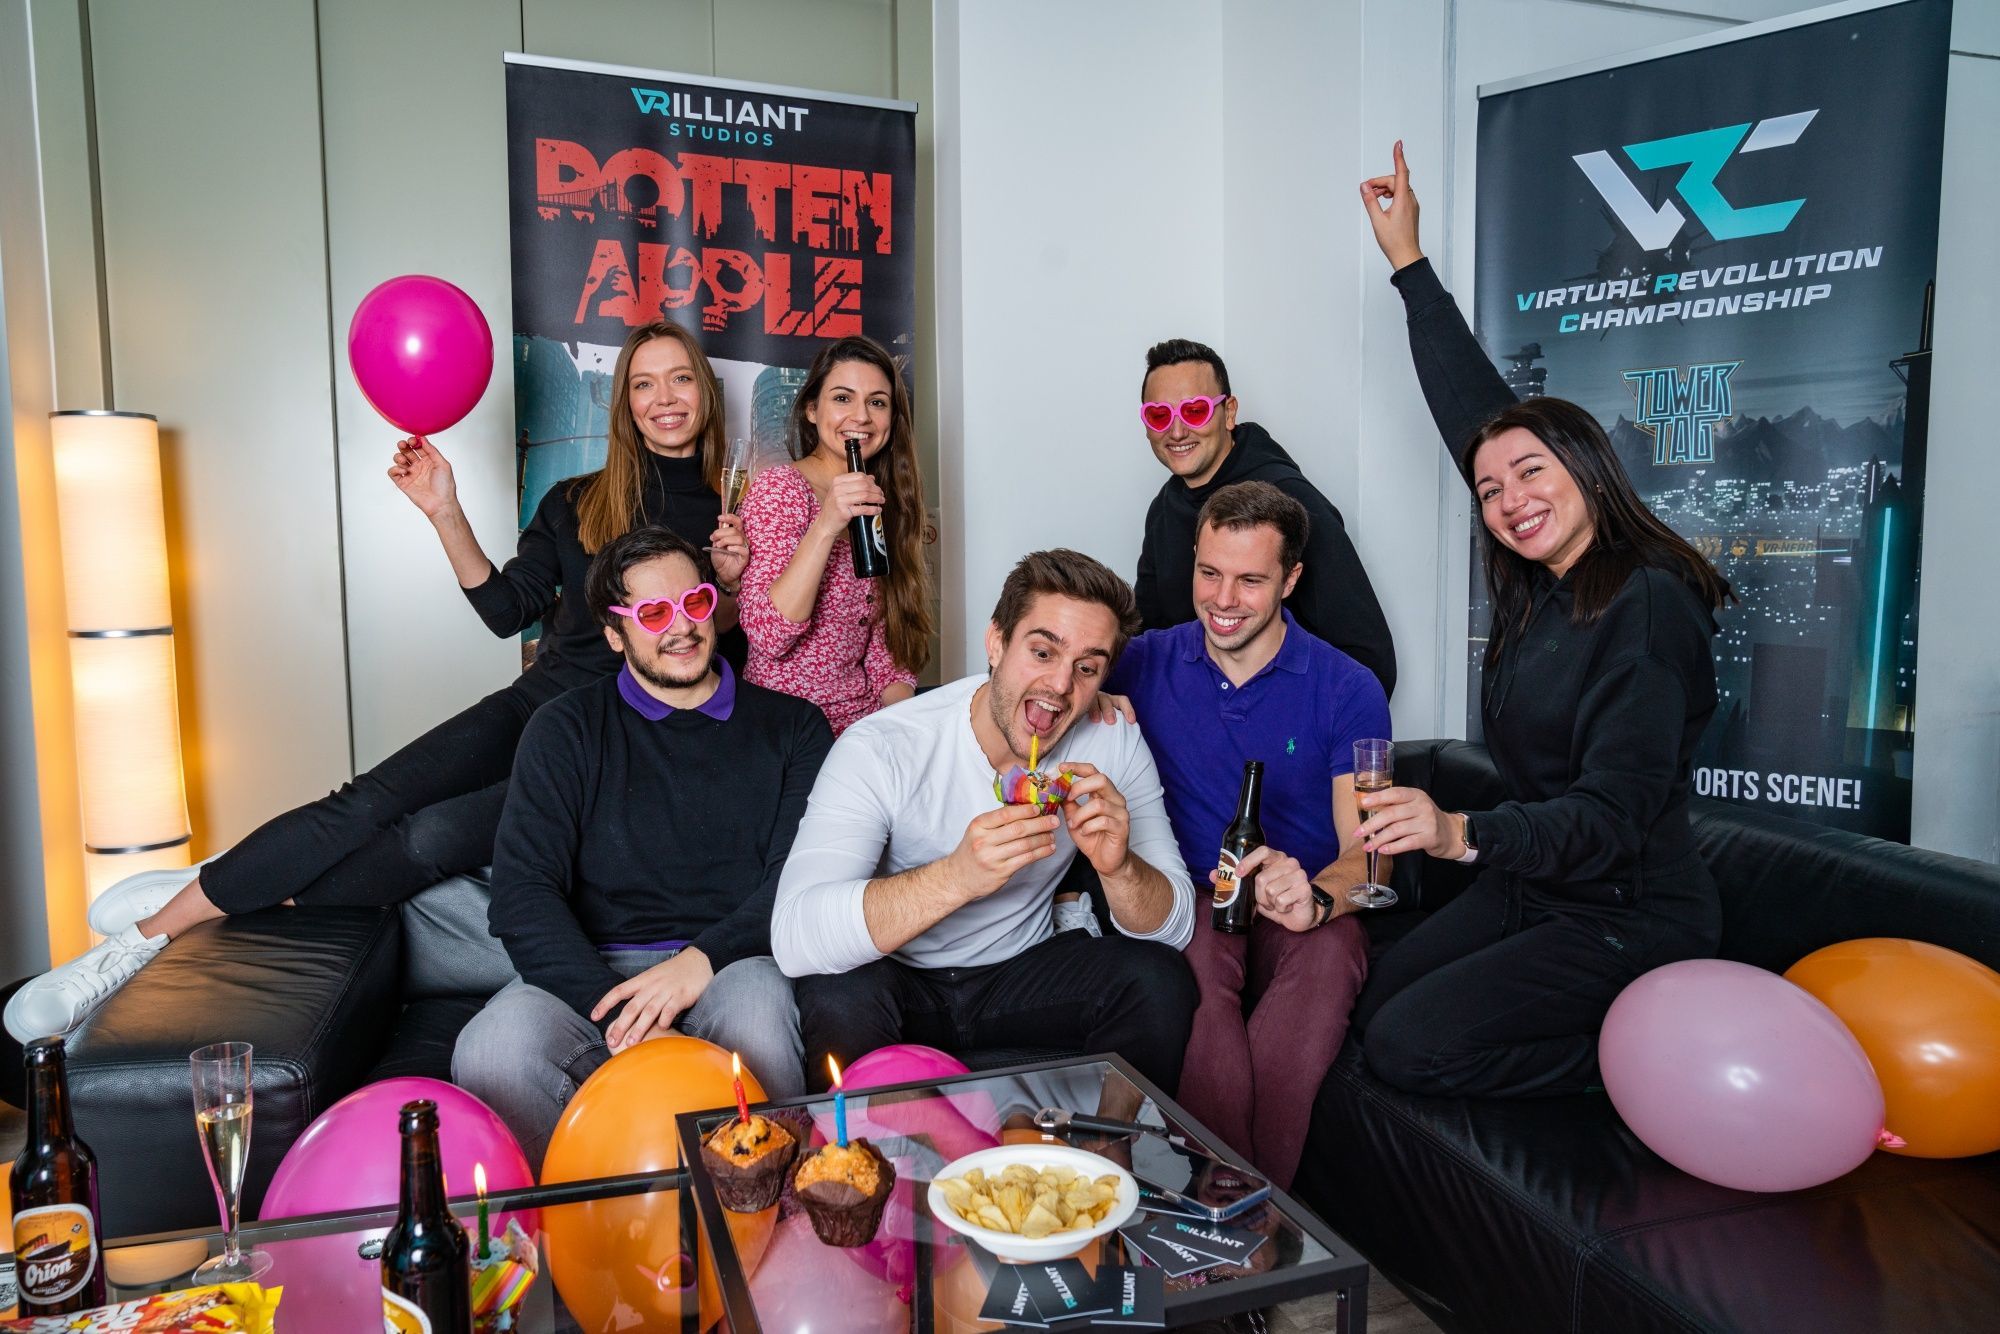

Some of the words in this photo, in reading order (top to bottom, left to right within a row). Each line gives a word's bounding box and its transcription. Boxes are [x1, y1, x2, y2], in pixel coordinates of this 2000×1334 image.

[669, 123, 773, 146] STUDIOS
[1516, 278, 1648, 311] VIRTUAL
[1653, 246, 1883, 294] REVOLUTION
[1558, 284, 1832, 333] CHAMPIONSHIP
[1621, 361, 1742, 424] TOWER
[1645, 412, 1723, 464] TAG
[1692, 767, 1760, 800] ORTS
[1766, 773, 1862, 810] SCENE!
[25, 1259, 77, 1288] Orion
